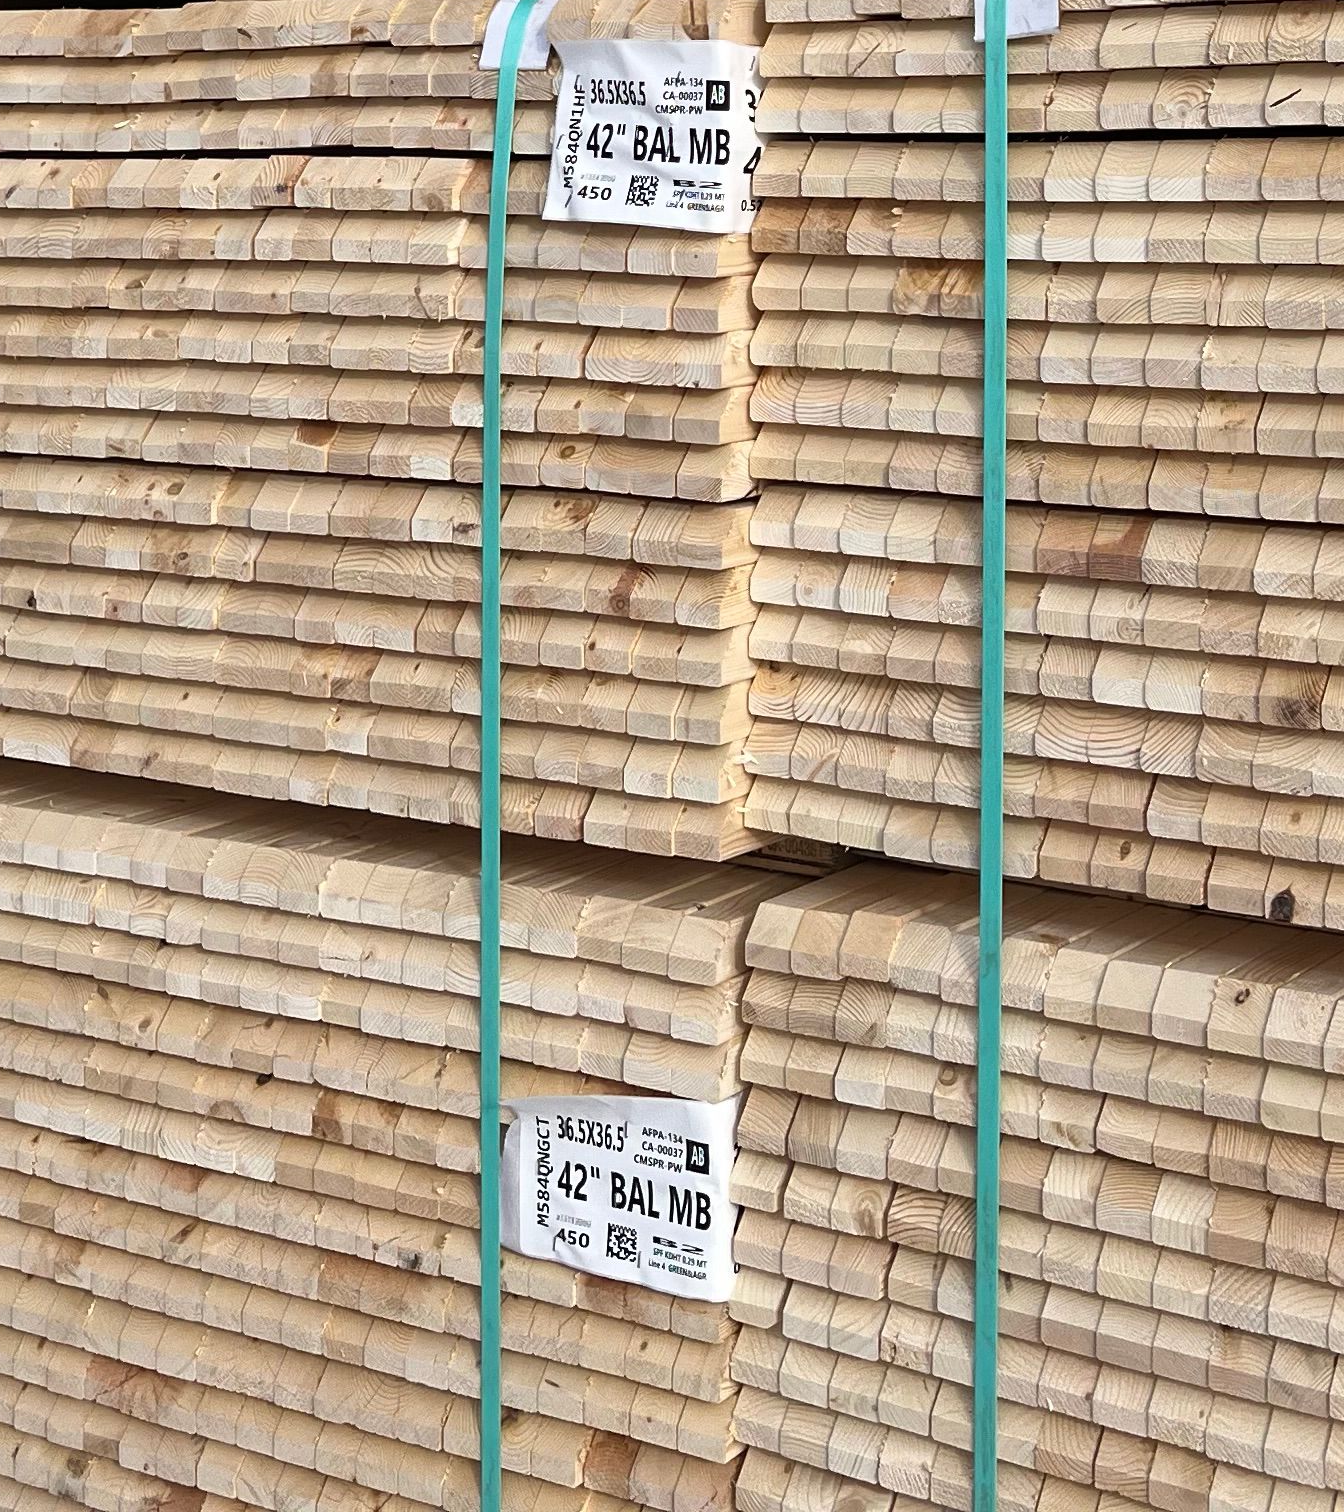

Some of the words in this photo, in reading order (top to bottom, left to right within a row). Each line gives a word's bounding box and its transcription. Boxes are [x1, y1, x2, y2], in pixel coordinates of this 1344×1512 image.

[590, 79, 646, 106] 36.5X36.5
[663, 91, 703, 101] CA-00037
[586, 123, 626, 159] 42"
[633, 125, 681, 164] BAL
[689, 127, 731, 166] MB
[577, 185, 612, 201] 450
[556, 1115, 625, 1153] 36.5X36.5
[641, 1127, 683, 1144] AFPA-134
[641, 1141, 683, 1159] CA-00037
[535, 1116, 554, 1228] M584QNGCT
[633, 1154, 683, 1173] CMSPR-PW
[557, 1160, 601, 1202] 42"
[610, 1170, 660, 1219] BAL
[668, 1184, 712, 1231] MB
[556, 1228, 590, 1249] 450
